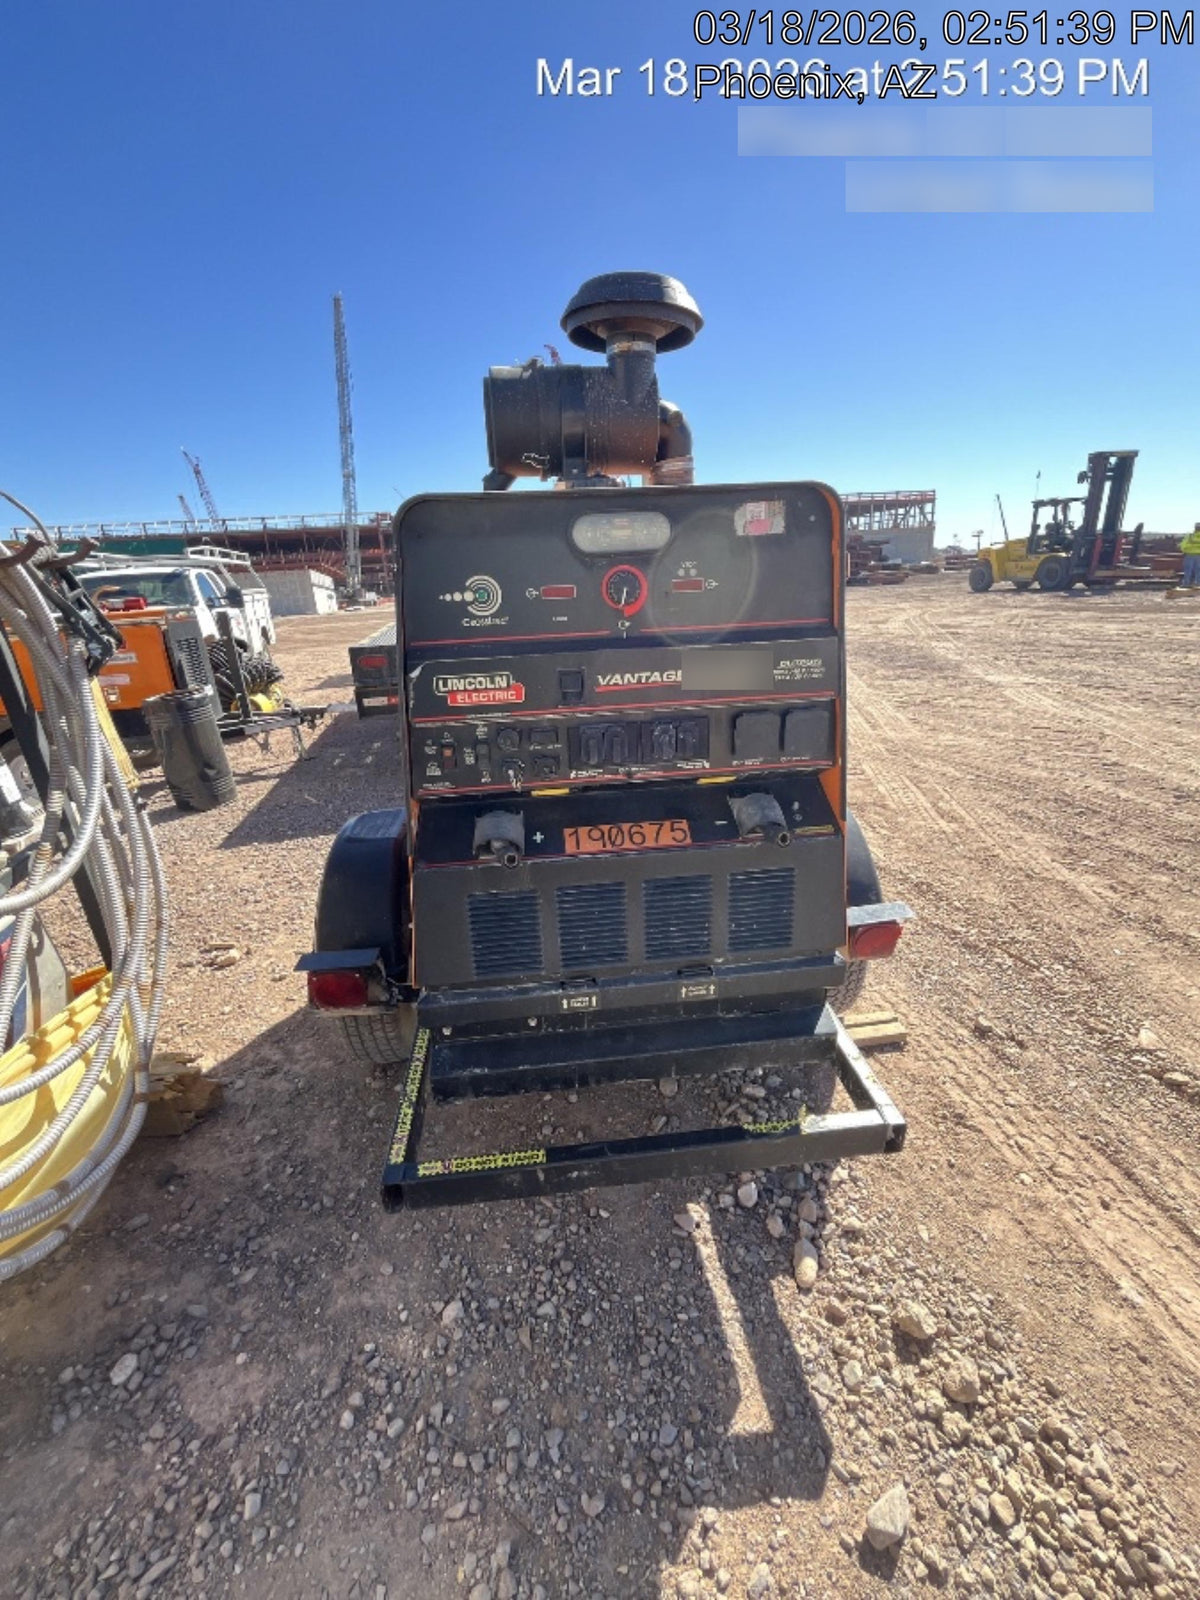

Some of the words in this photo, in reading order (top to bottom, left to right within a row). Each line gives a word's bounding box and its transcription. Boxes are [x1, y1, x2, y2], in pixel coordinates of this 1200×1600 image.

[438, 675, 508, 692] LINCOLN
[596, 669, 682, 687] VANTAG
[456, 690, 517, 703] ELECTRIC
[568, 820, 688, 850] 190675
